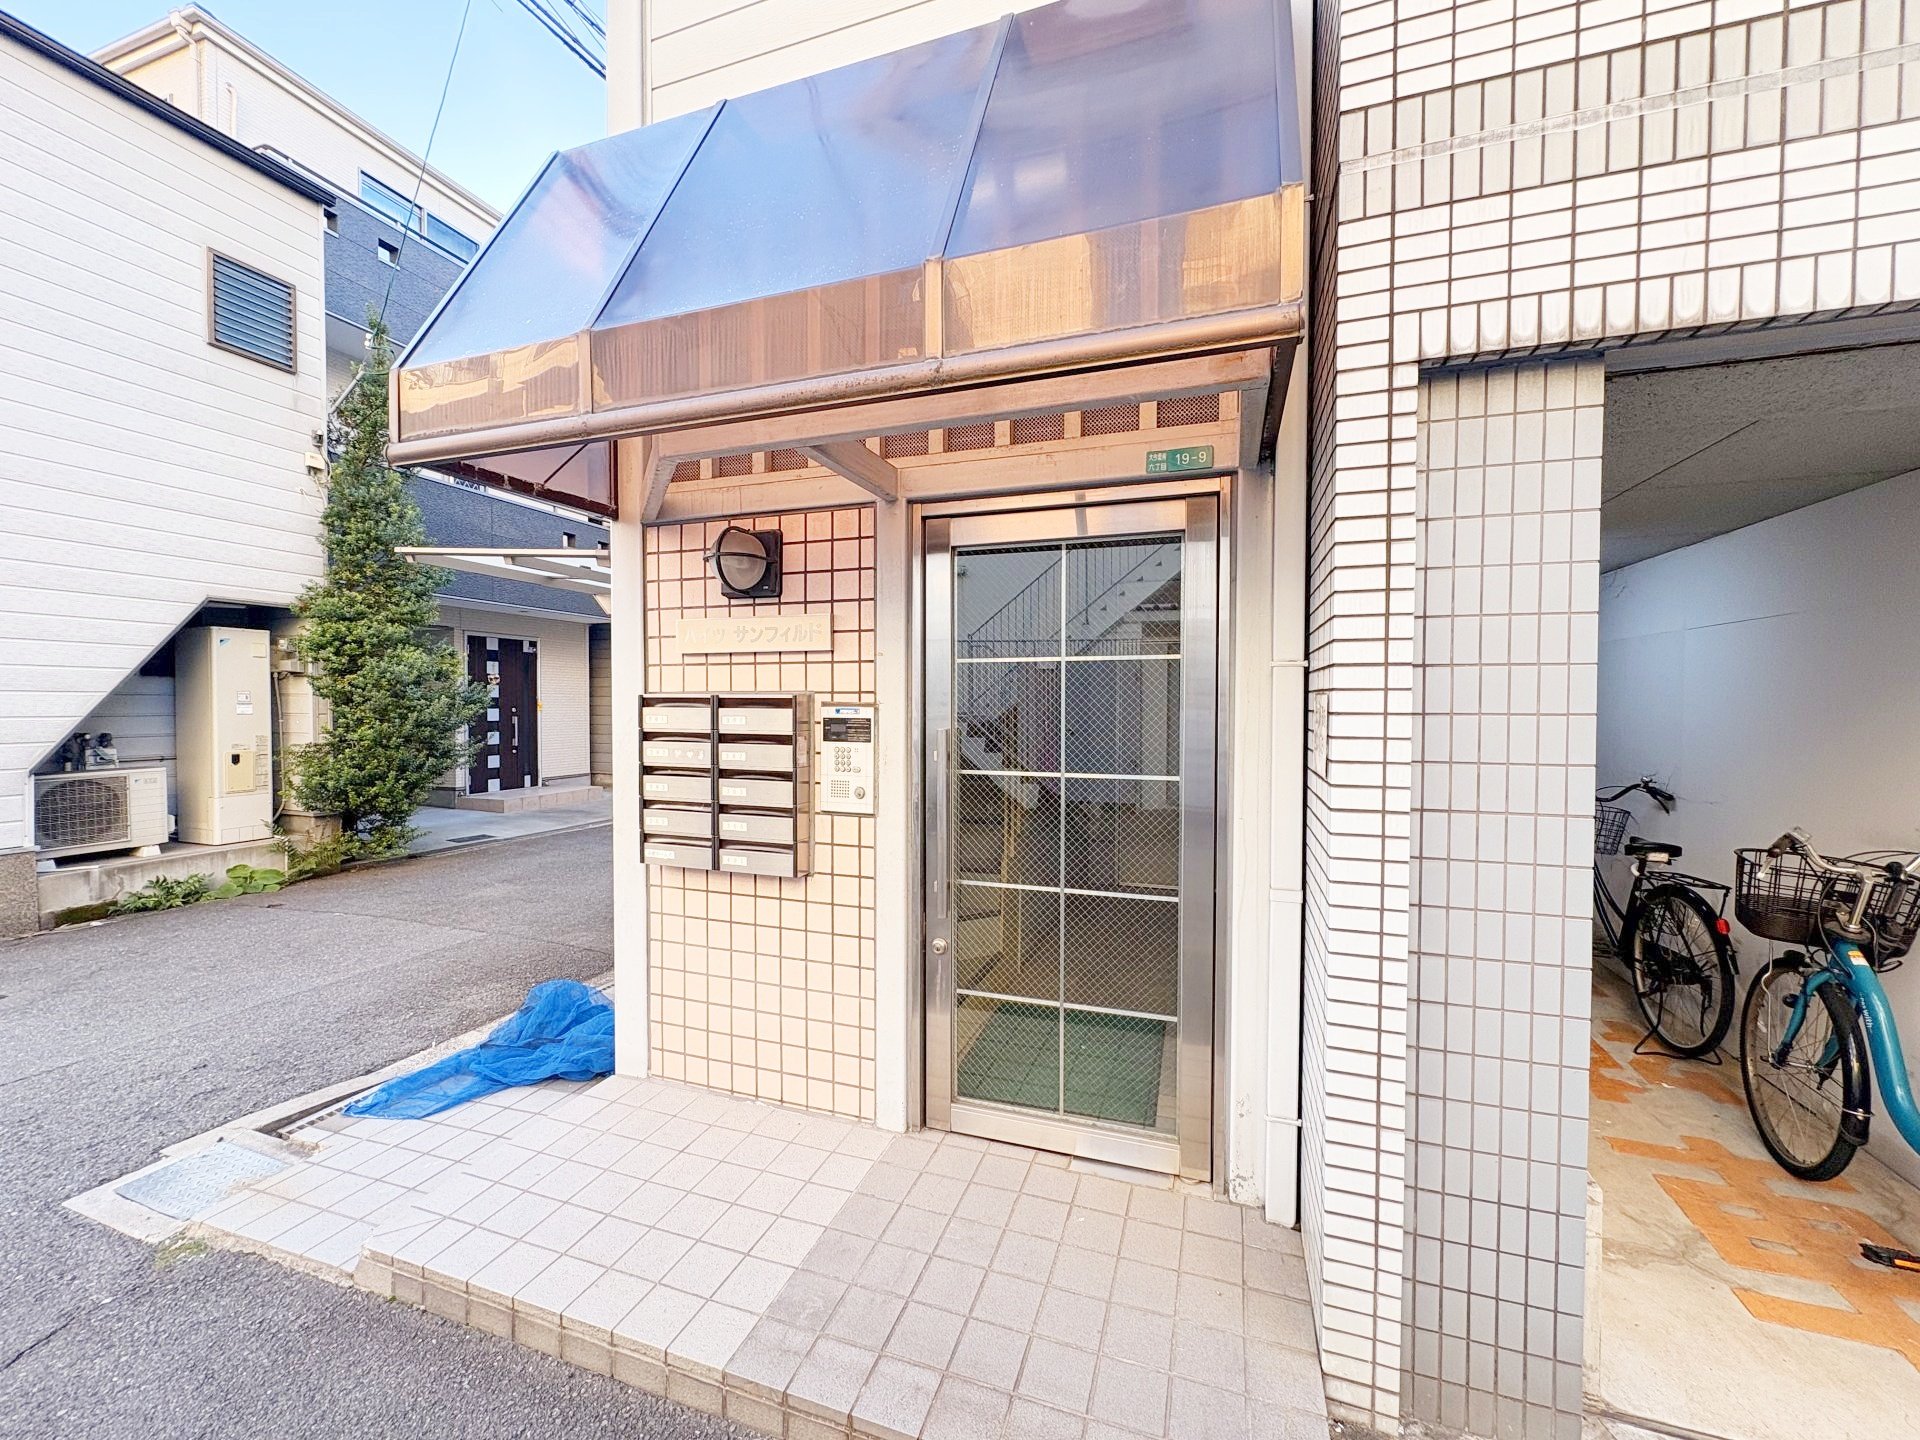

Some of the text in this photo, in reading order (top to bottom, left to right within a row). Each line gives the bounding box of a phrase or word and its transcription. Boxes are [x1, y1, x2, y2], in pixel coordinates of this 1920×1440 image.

[1175, 451, 1207, 465] 19-9
[1148, 463, 1167, 471] 六丁目
[734, 622, 822, 643] サンフィルド
